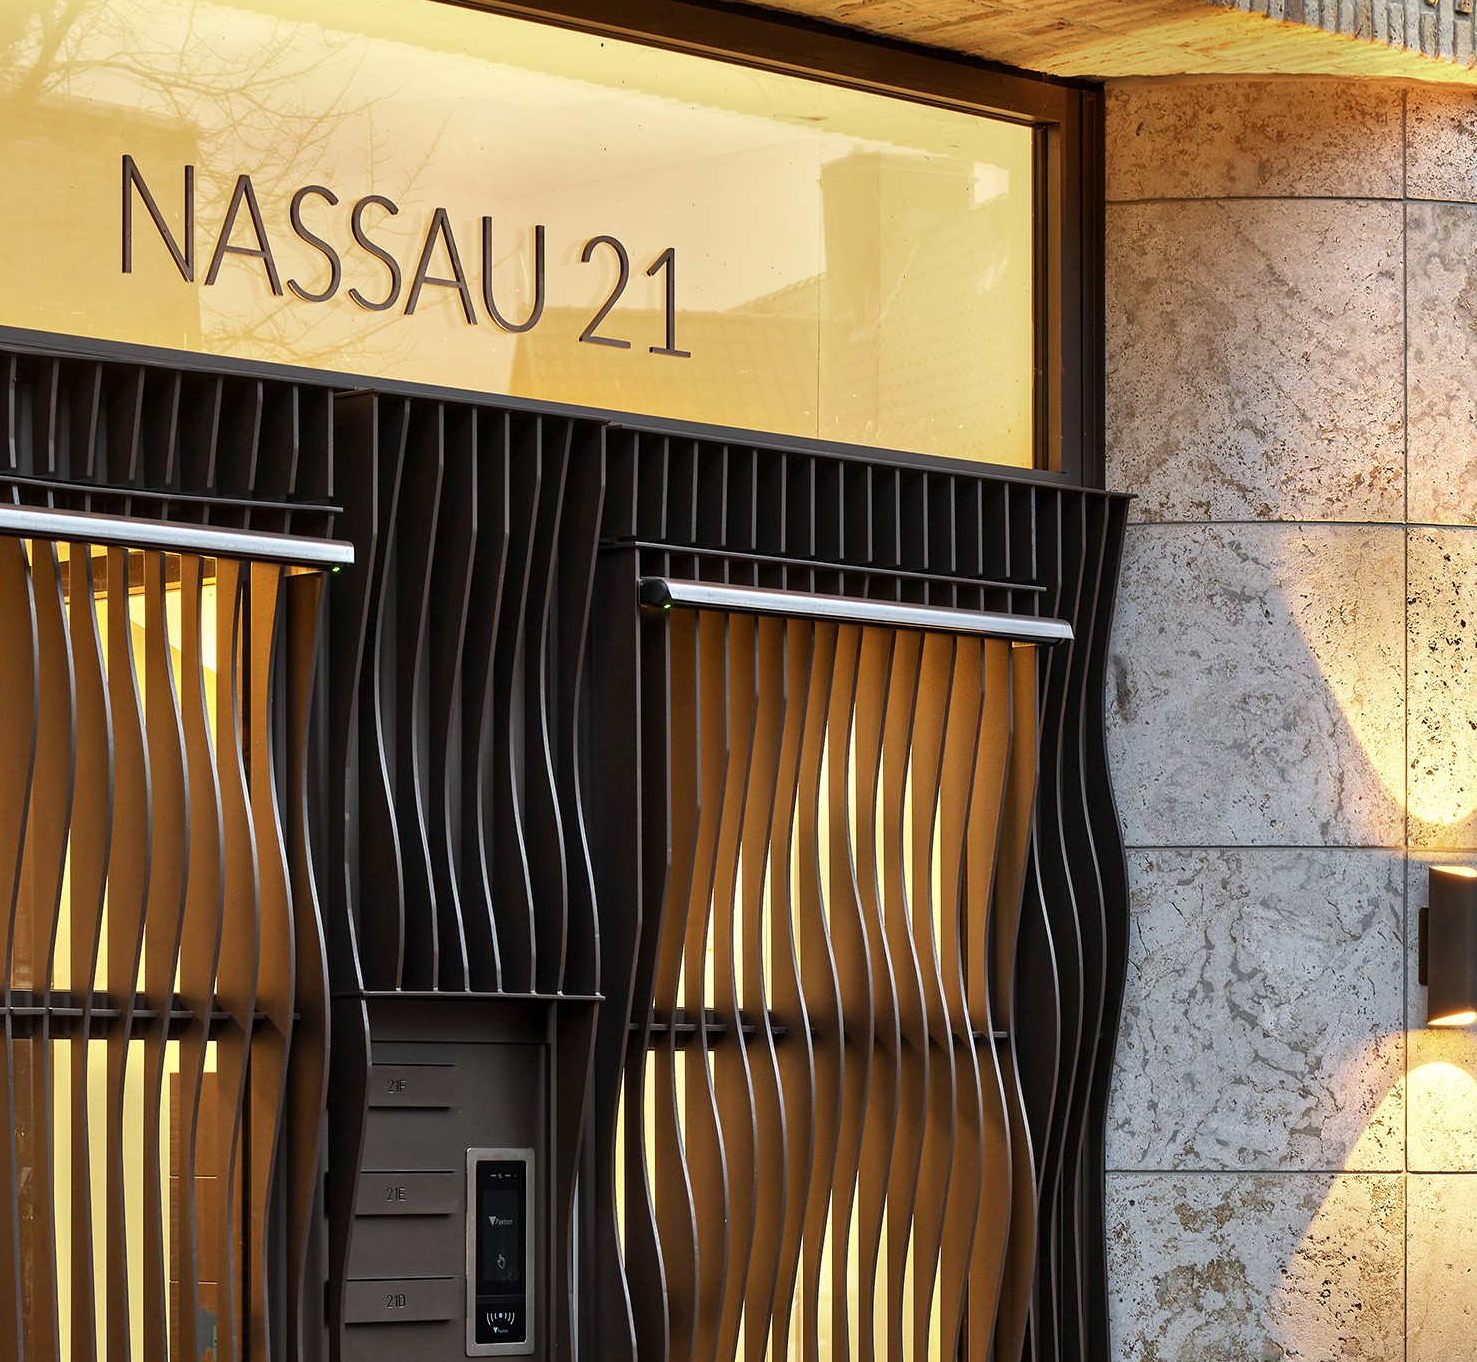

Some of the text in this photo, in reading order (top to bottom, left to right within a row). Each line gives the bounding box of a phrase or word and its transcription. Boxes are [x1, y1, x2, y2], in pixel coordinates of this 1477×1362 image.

[121, 154, 691, 358] NASSAU 21
[388, 1079, 407, 1094] 21F
[387, 1187, 406, 1202] 21E
[387, 1293, 406, 1309] 21D
